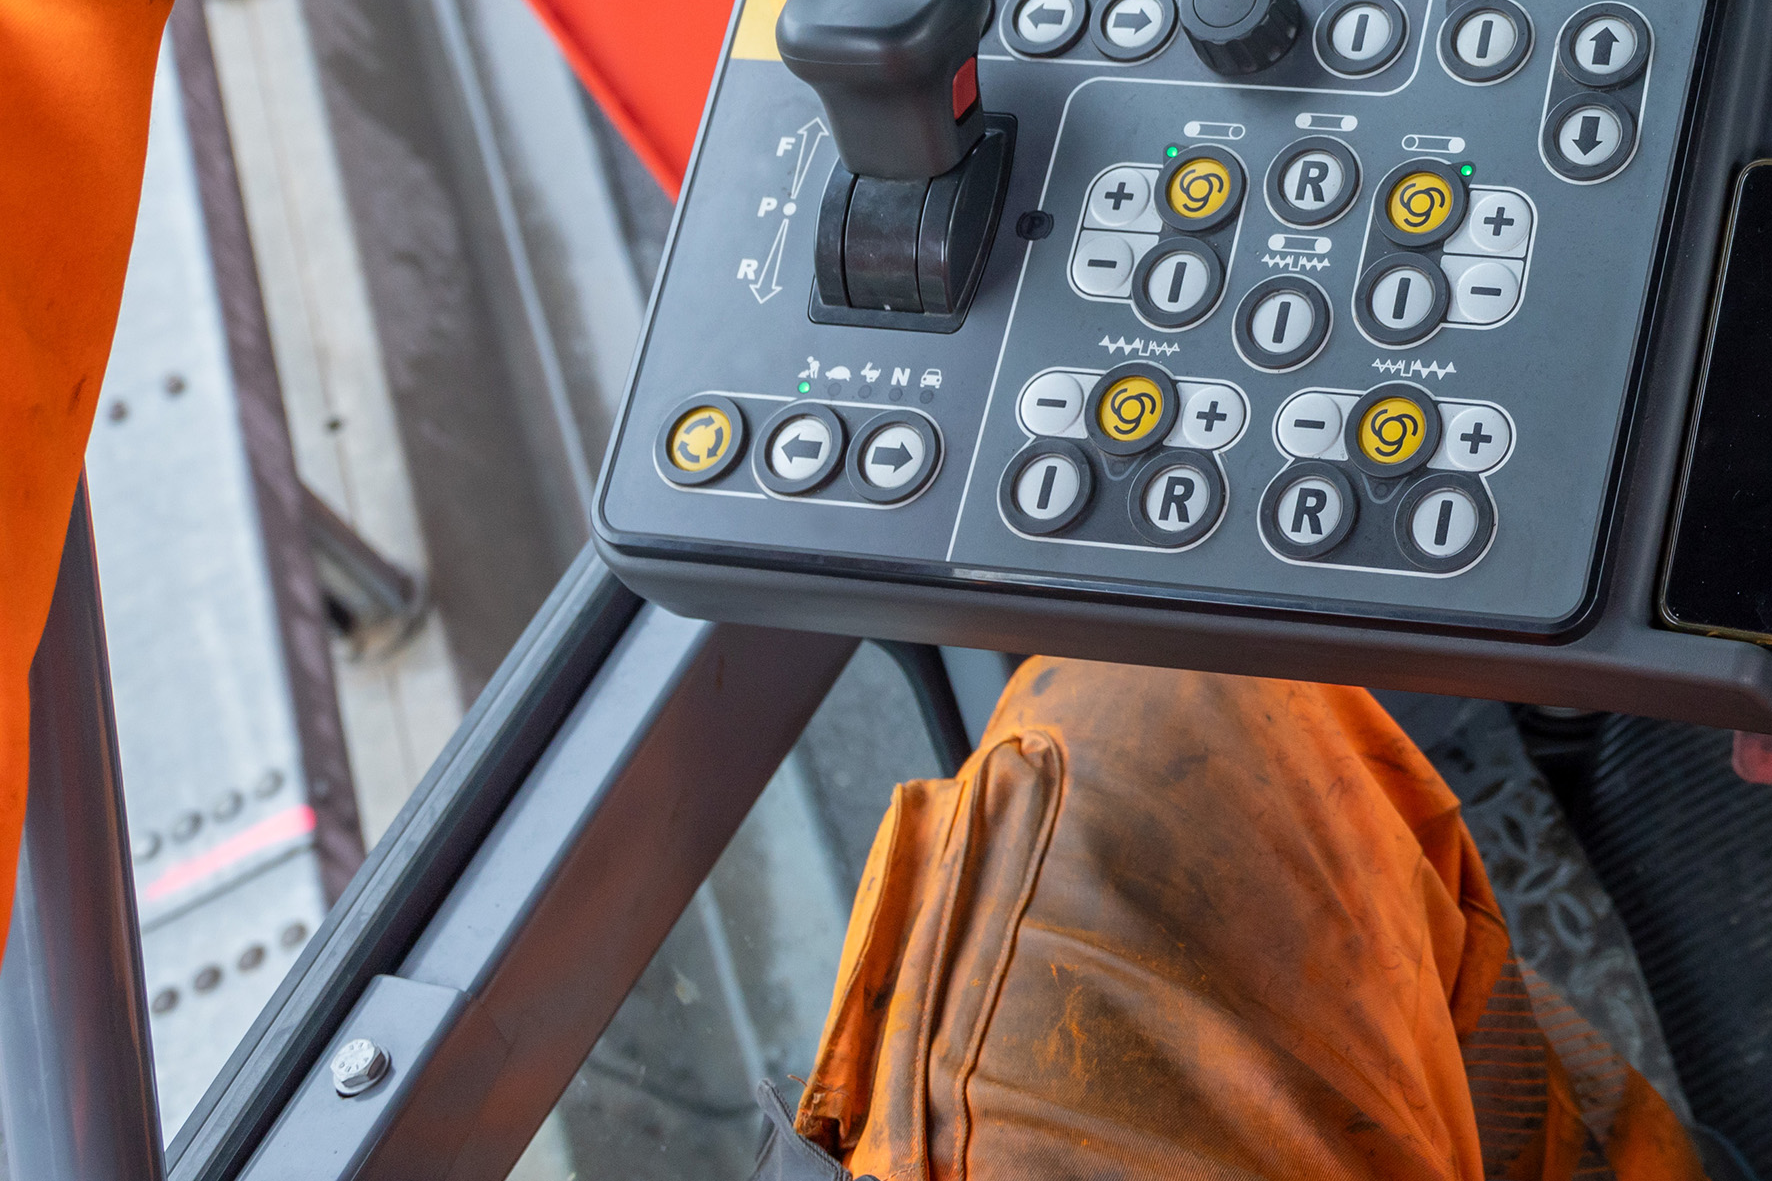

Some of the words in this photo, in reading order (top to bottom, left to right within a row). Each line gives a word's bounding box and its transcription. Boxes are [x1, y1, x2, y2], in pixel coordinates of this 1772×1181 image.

[776, 137, 796, 157] F
[1294, 160, 1329, 203] R
[757, 197, 778, 217] P
[736, 258, 759, 280] R
[891, 367, 911, 386] N
[1158, 476, 1195, 524] R
[1290, 488, 1328, 536] R
